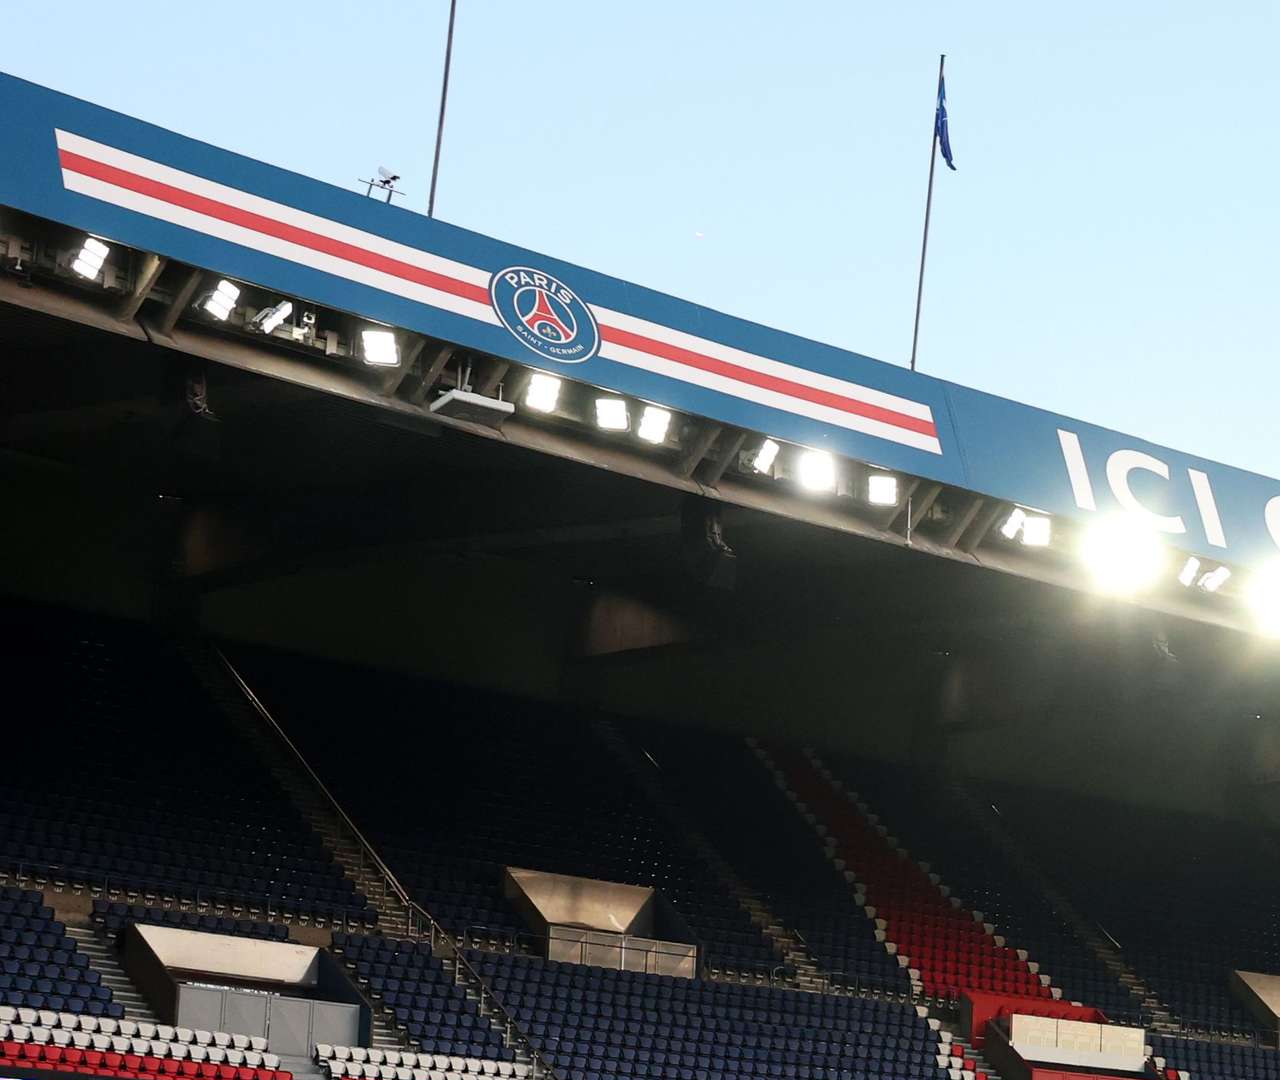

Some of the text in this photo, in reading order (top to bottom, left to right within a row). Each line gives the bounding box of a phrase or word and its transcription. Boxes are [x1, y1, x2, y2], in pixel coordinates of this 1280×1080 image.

[504, 271, 574, 304] PARIS
[516, 325, 542, 347] SAINT
[1057, 428, 1229, 549] ICI
